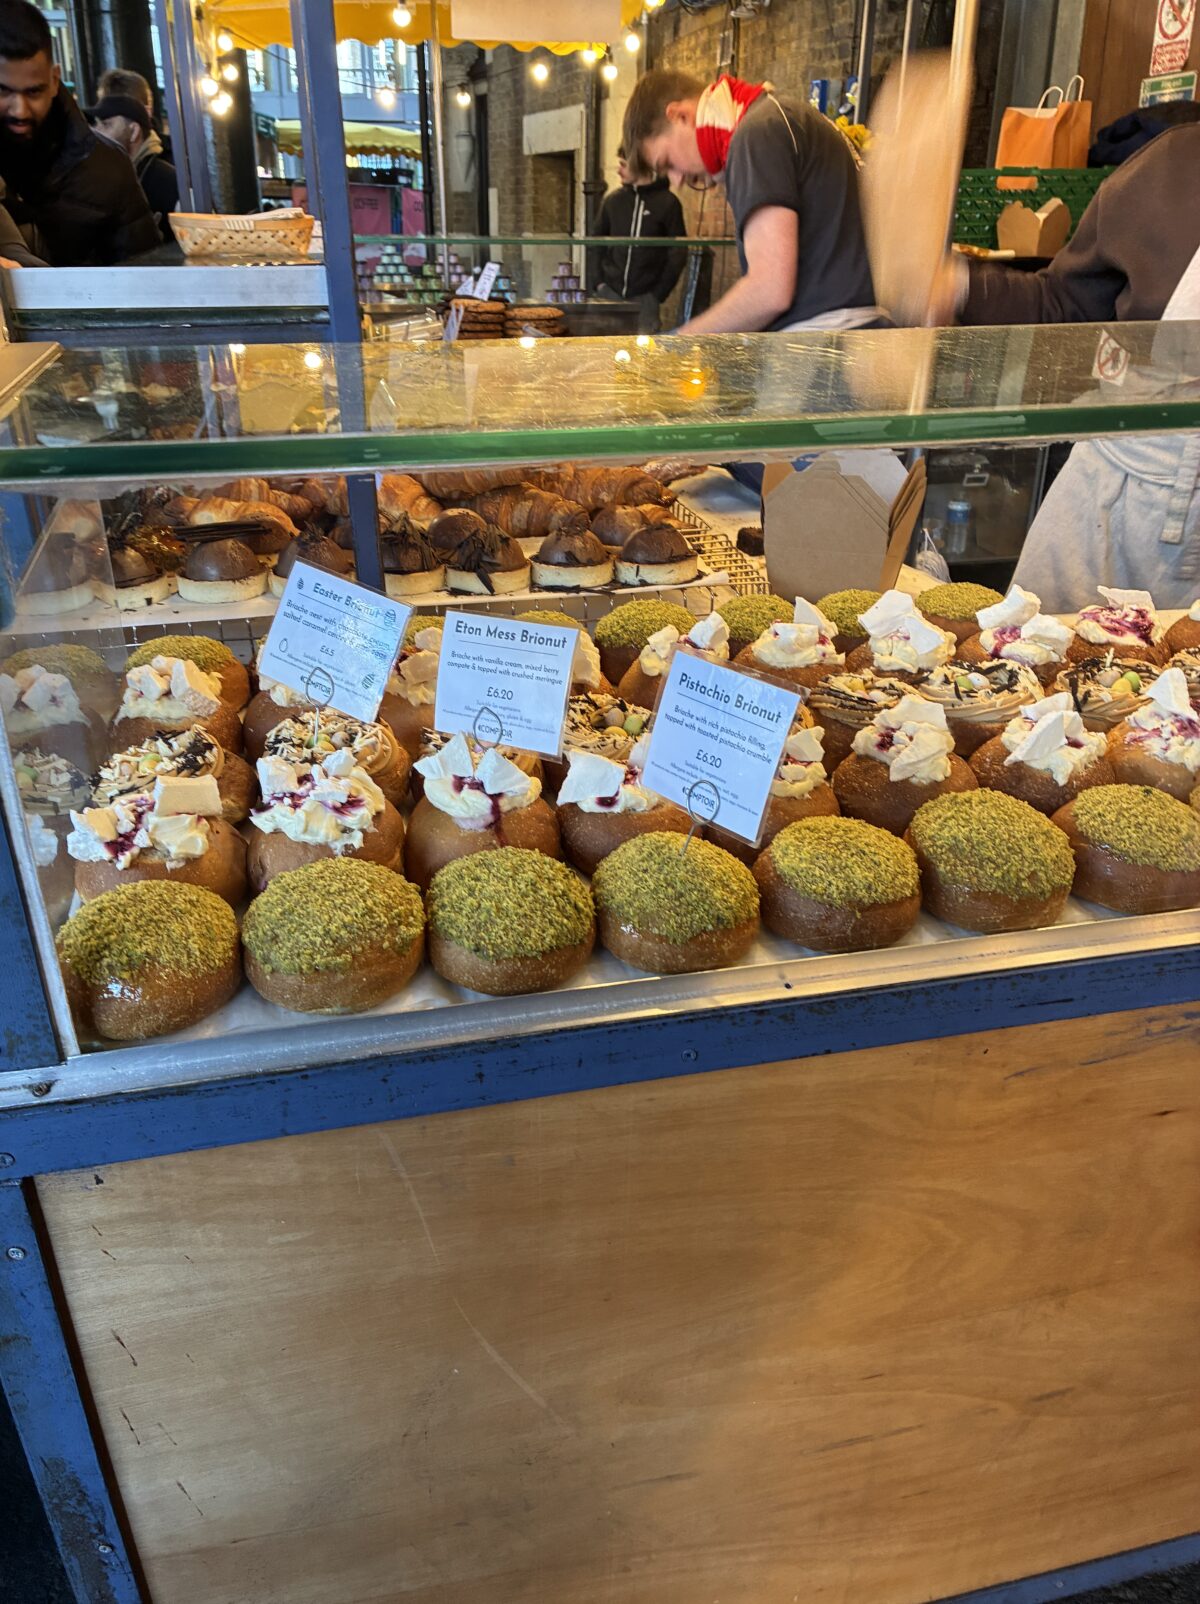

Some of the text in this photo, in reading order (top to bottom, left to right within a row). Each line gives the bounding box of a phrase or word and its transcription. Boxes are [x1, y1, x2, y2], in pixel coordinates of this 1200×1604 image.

[313, 582, 343, 602] Easter
[283, 609, 302, 622] salted
[301, 618, 327, 633] caramel
[286, 599, 308, 614] Brioche
[308, 610, 322, 620] nest
[323, 615, 337, 626] with
[455, 620, 567, 648] Eton Mess Brionut
[447, 660, 469, 669] compote
[477, 664, 497, 674] topped
[498, 667, 510, 675] with
[511, 670, 534, 679] crushed
[534, 675, 562, 685] meringue
[451, 650, 470, 659] Brioche
[484, 656, 503, 665] vanilla
[524, 663, 542, 671] mixed
[543, 665, 558, 675] berry
[486, 686, 513, 700] £6.20
[678, 672, 782, 723] Pistachio Brionut
[480, 724, 512, 738] COMPOIR
[664, 712, 772, 764] topped with toasted pistachio crumble
[674, 704, 766, 750] Brioche with rich pistachio filling,
[695, 748, 721, 768] £6.20
